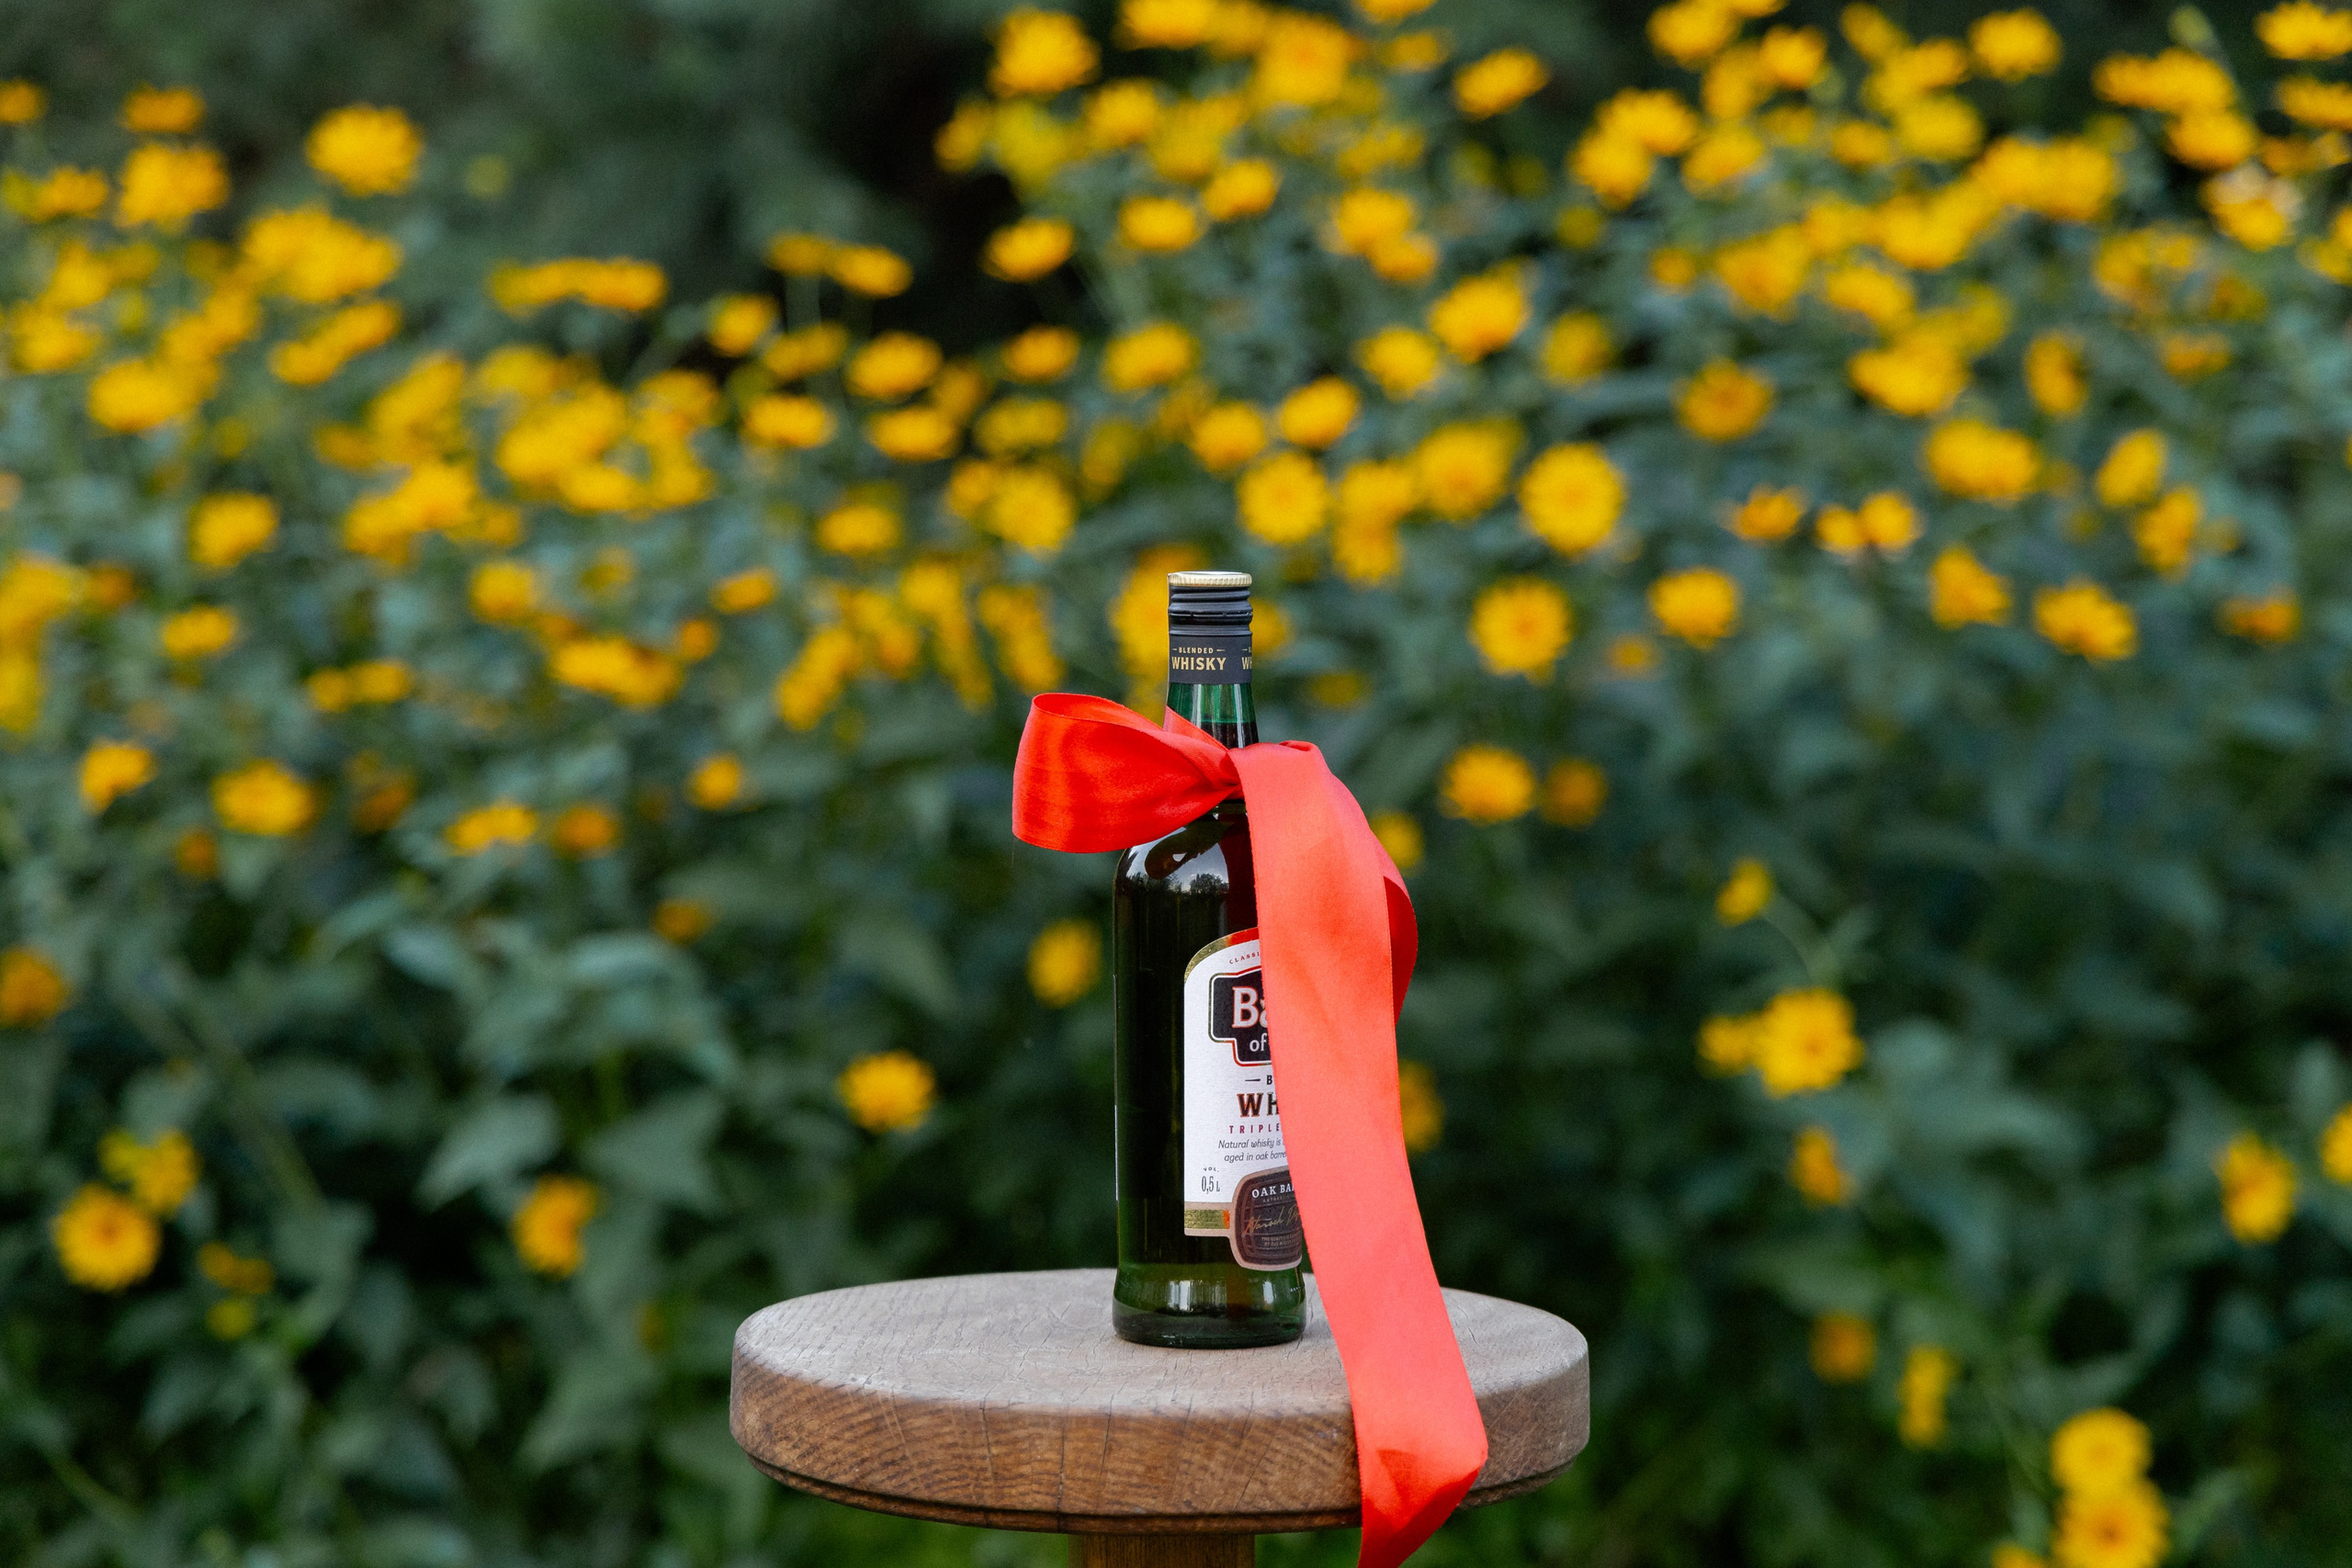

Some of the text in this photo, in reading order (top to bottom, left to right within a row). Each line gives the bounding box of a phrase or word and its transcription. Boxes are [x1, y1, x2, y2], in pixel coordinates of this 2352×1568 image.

[1171, 656, 1227, 671] WHISKY
[1250, 1032, 1267, 1052] of
[1229, 1122, 1280, 1134] TRIPLE
[1217, 1137, 1282, 1149] Natural whisky is
[1224, 1153, 1244, 1164] aged
[1246, 1152, 1253, 1161] in
[1255, 1150, 1269, 1160] oak
[1251, 1186, 1277, 1199] OAK
